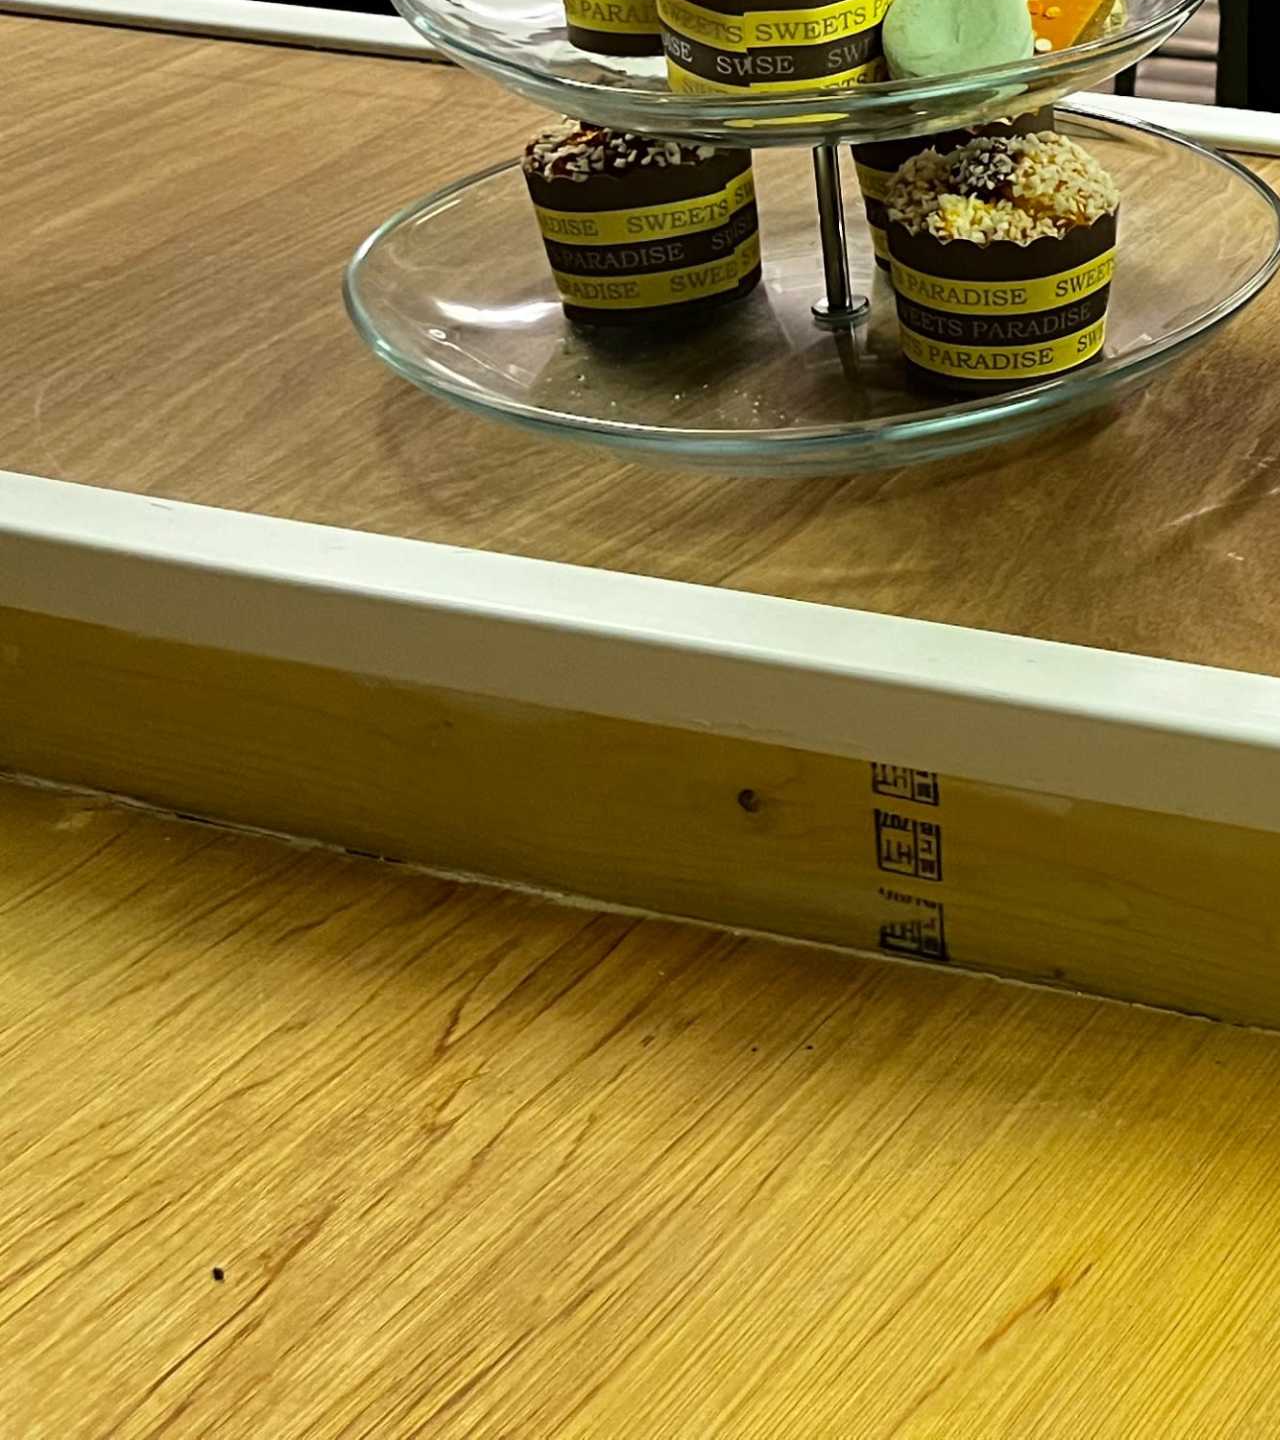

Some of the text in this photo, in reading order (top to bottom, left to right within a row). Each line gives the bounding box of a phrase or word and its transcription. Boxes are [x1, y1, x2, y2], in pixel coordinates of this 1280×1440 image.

[755, 10, 867, 42] SWEETS
[626, 198, 729, 235] SWEETS
[906, 274, 1027, 307] PARADISE
[972, 302, 1092, 339] PARADISE
[928, 347, 1054, 370] PARADISE
